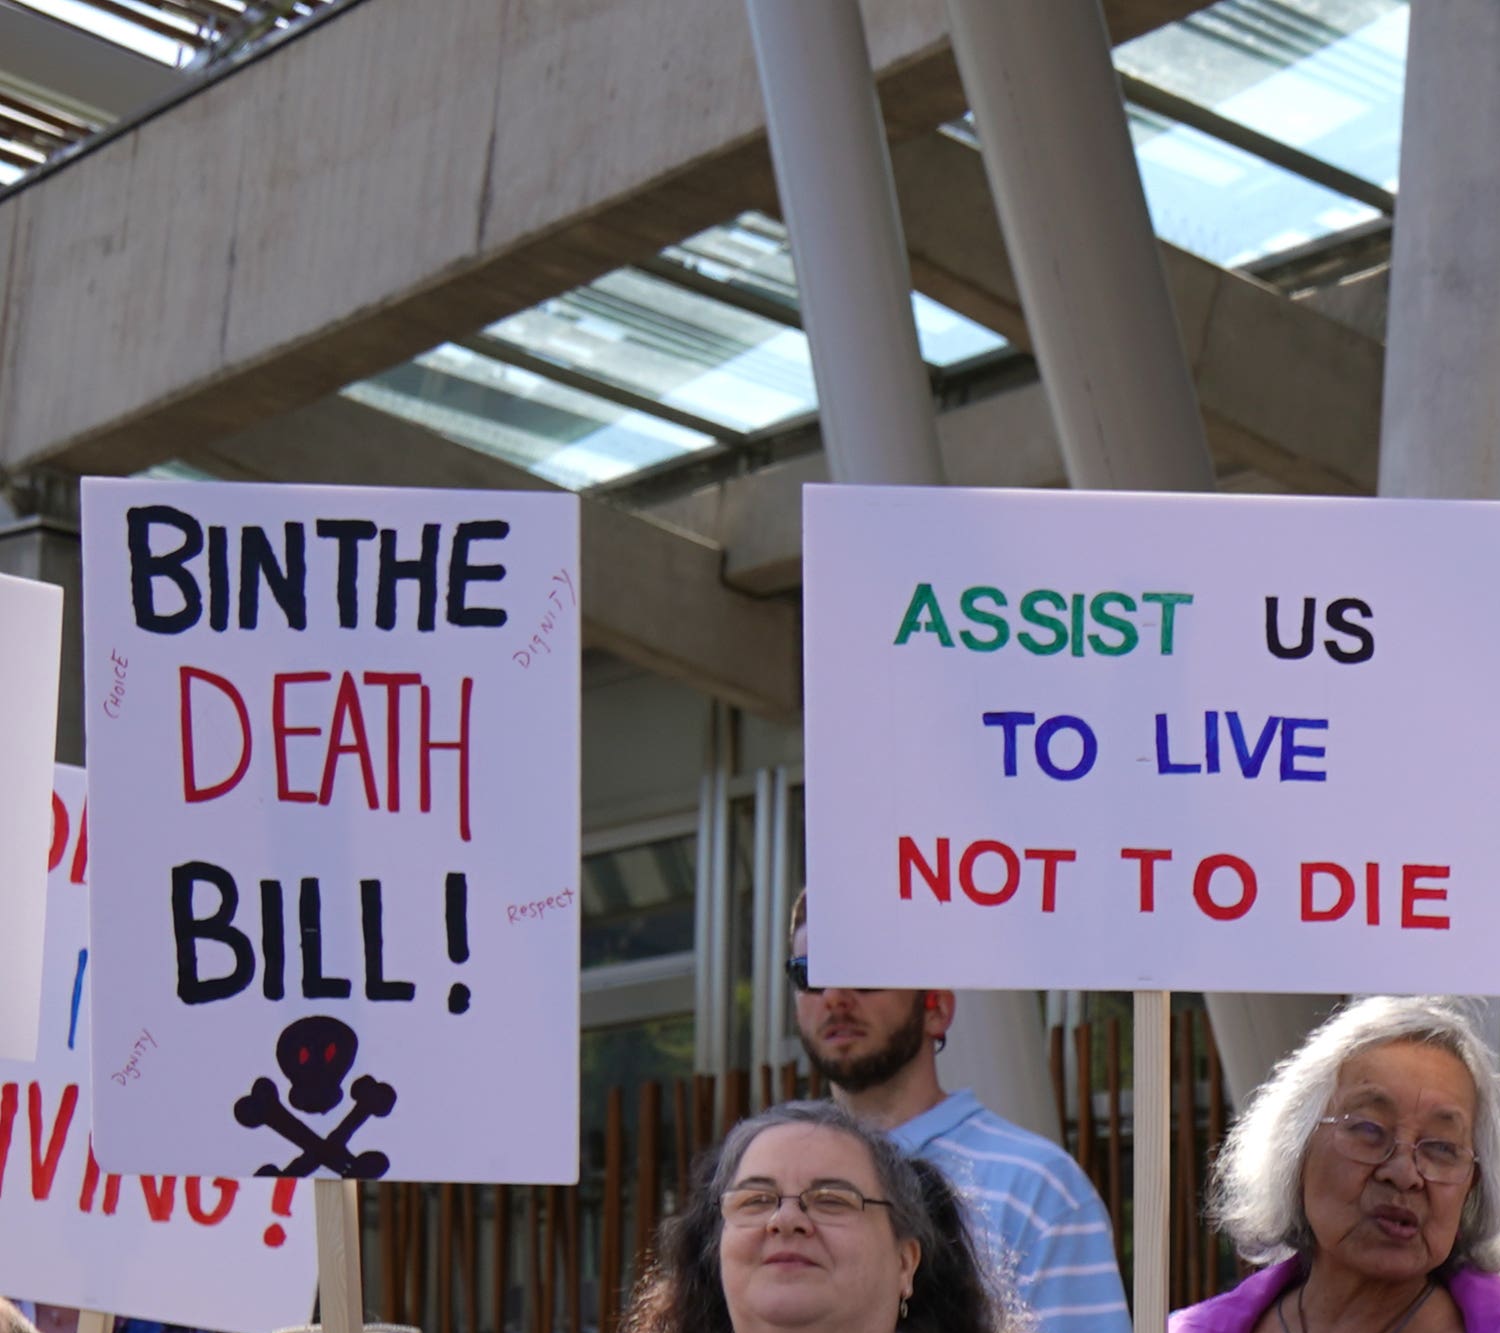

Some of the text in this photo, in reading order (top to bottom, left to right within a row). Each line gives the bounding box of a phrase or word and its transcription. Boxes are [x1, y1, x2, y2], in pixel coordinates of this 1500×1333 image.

[126, 504, 510, 635] BIN THE
[894, 582, 1376, 665] ASSIST US
[179, 665, 474, 842] DEATH
[981, 710, 1331, 783] TO LIVE
[171, 861, 472, 1015] BILL!
[897, 835, 1452, 931] NOT TO DIE
